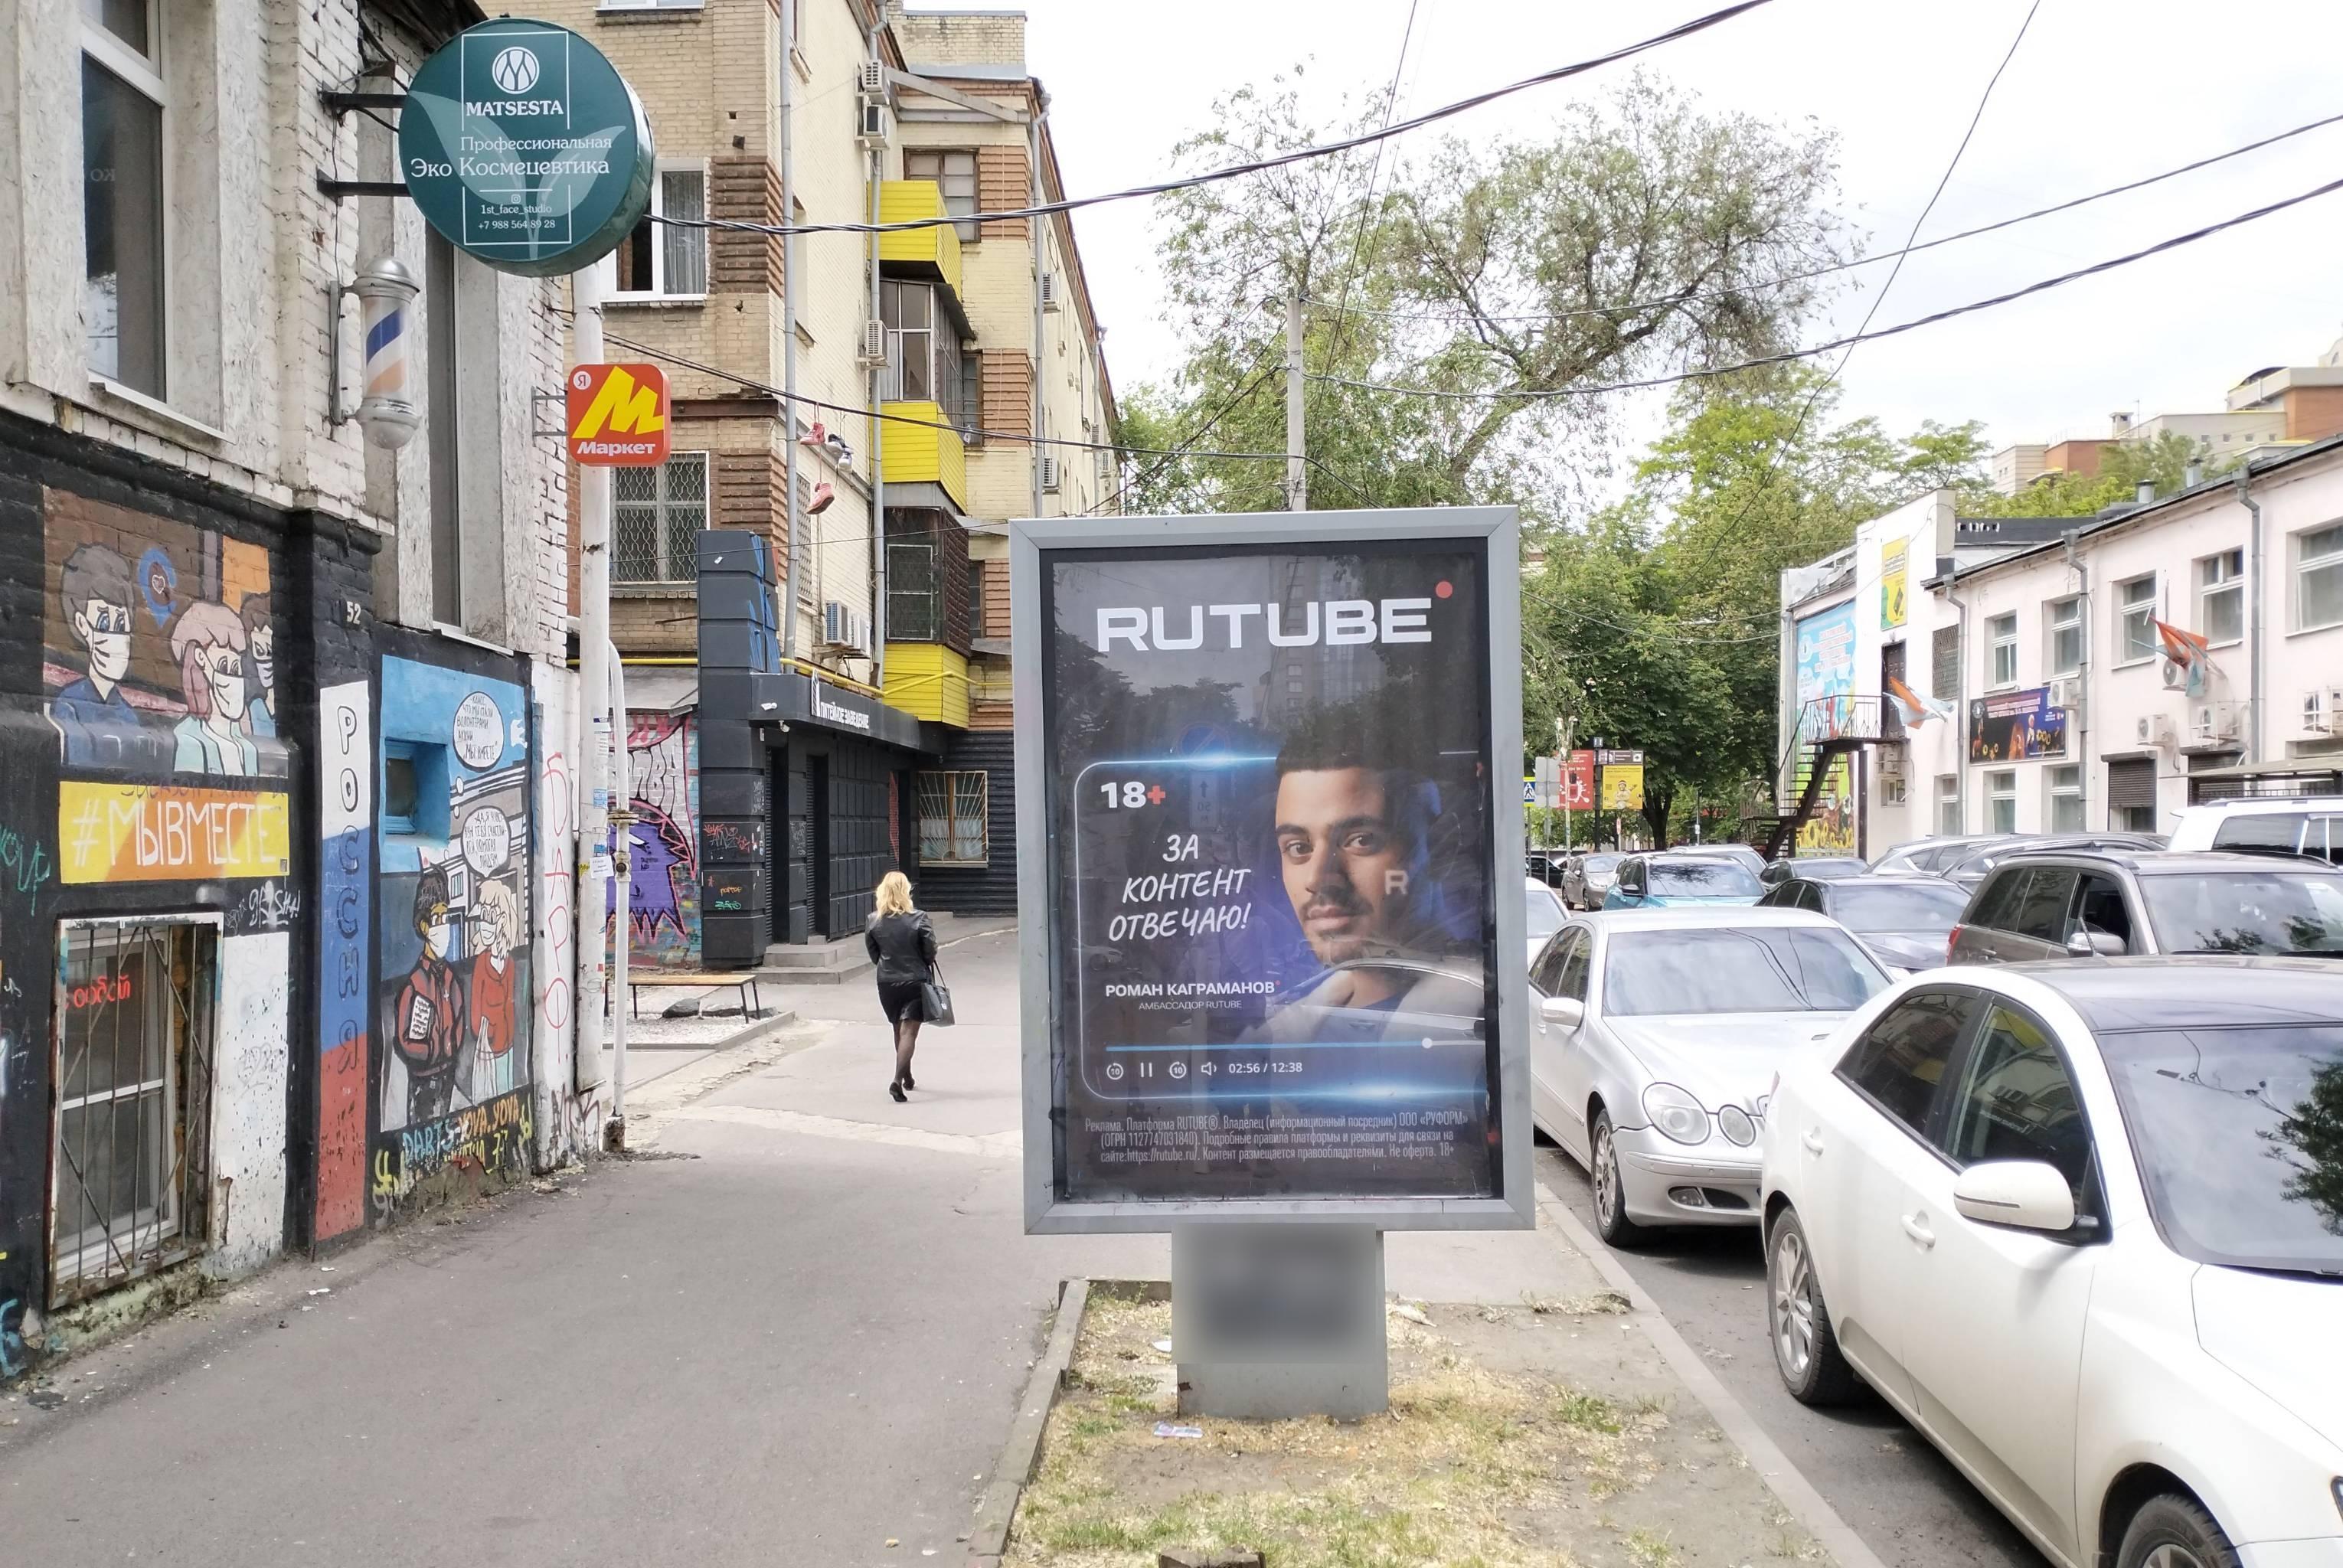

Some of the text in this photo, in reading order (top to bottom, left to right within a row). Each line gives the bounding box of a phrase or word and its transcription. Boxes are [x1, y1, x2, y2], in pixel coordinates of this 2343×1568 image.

[466, 100, 564, 116] MATSESTA
[460, 136, 612, 153] Профессиональная
[410, 157, 609, 178] Эко Космецевтика
[481, 204, 552, 215] 1st_face_studio
[479, 220, 556, 230] +7 988 564 89 28
[577, 441, 656, 457] Маркет
[346, 601, 361, 625] 52
[1096, 598, 1432, 652] RUTUBE
[1100, 781, 1166, 808] 18+
[72, 798, 276, 867] #МЫВМЕСТЕ
[1162, 834, 1199, 862] ЗА
[337, 704, 360, 1075] РОССИЯ
[1122, 868, 1252, 903] КОНТЕНТ
[1384, 870, 1410, 895] R
[1109, 903, 1252, 942] ОТВЕЧАЮ!
[1105, 981, 1275, 997] РОМАН КАГРАМАНОВ
[1139, 1000, 1242, 1011] АМБАССАДОР RUTUBE
[1228, 1063, 1260, 1073] 02:56
[1271, 1062, 1303, 1073] 12:38
[1085, 1117, 1124, 1132] Реклама.
[1126, 1116, 1175, 1132] Платформа
[1224, 1115, 1264, 1131] Владелец
[1266, 1114, 1346, 1132] (информационный
[1348, 1112, 1397, 1131] посредник)
[1399, 1112, 1417, 1127] ООО
[1420, 1110, 1469, 1126] «РУФОРМ»
[1100, 1132, 1126, 1150] (ОГРН
[1203, 1130, 1252, 1148] Подробные
[1253, 1133, 1289, 1148] правила
[1291, 1131, 1341, 1147] платформы
[1342, 1133, 1348, 1143] и
[1351, 1131, 1397, 1146] реквизиты
[1399, 1131, 1414, 1144] для
[1417, 1130, 1442, 1142] связи
[1443, 1130, 1454, 1142] на
[1203, 1146, 1237, 1161] Контент
[1239, 1148, 1296, 1164] размещается
[1298, 1144, 1387, 1162] правообладателями.
[1389, 1144, 1400, 1158] Не
[1403, 1143, 1437, 1161] оферта.
[1439, 1142, 1455, 1157] 18+
